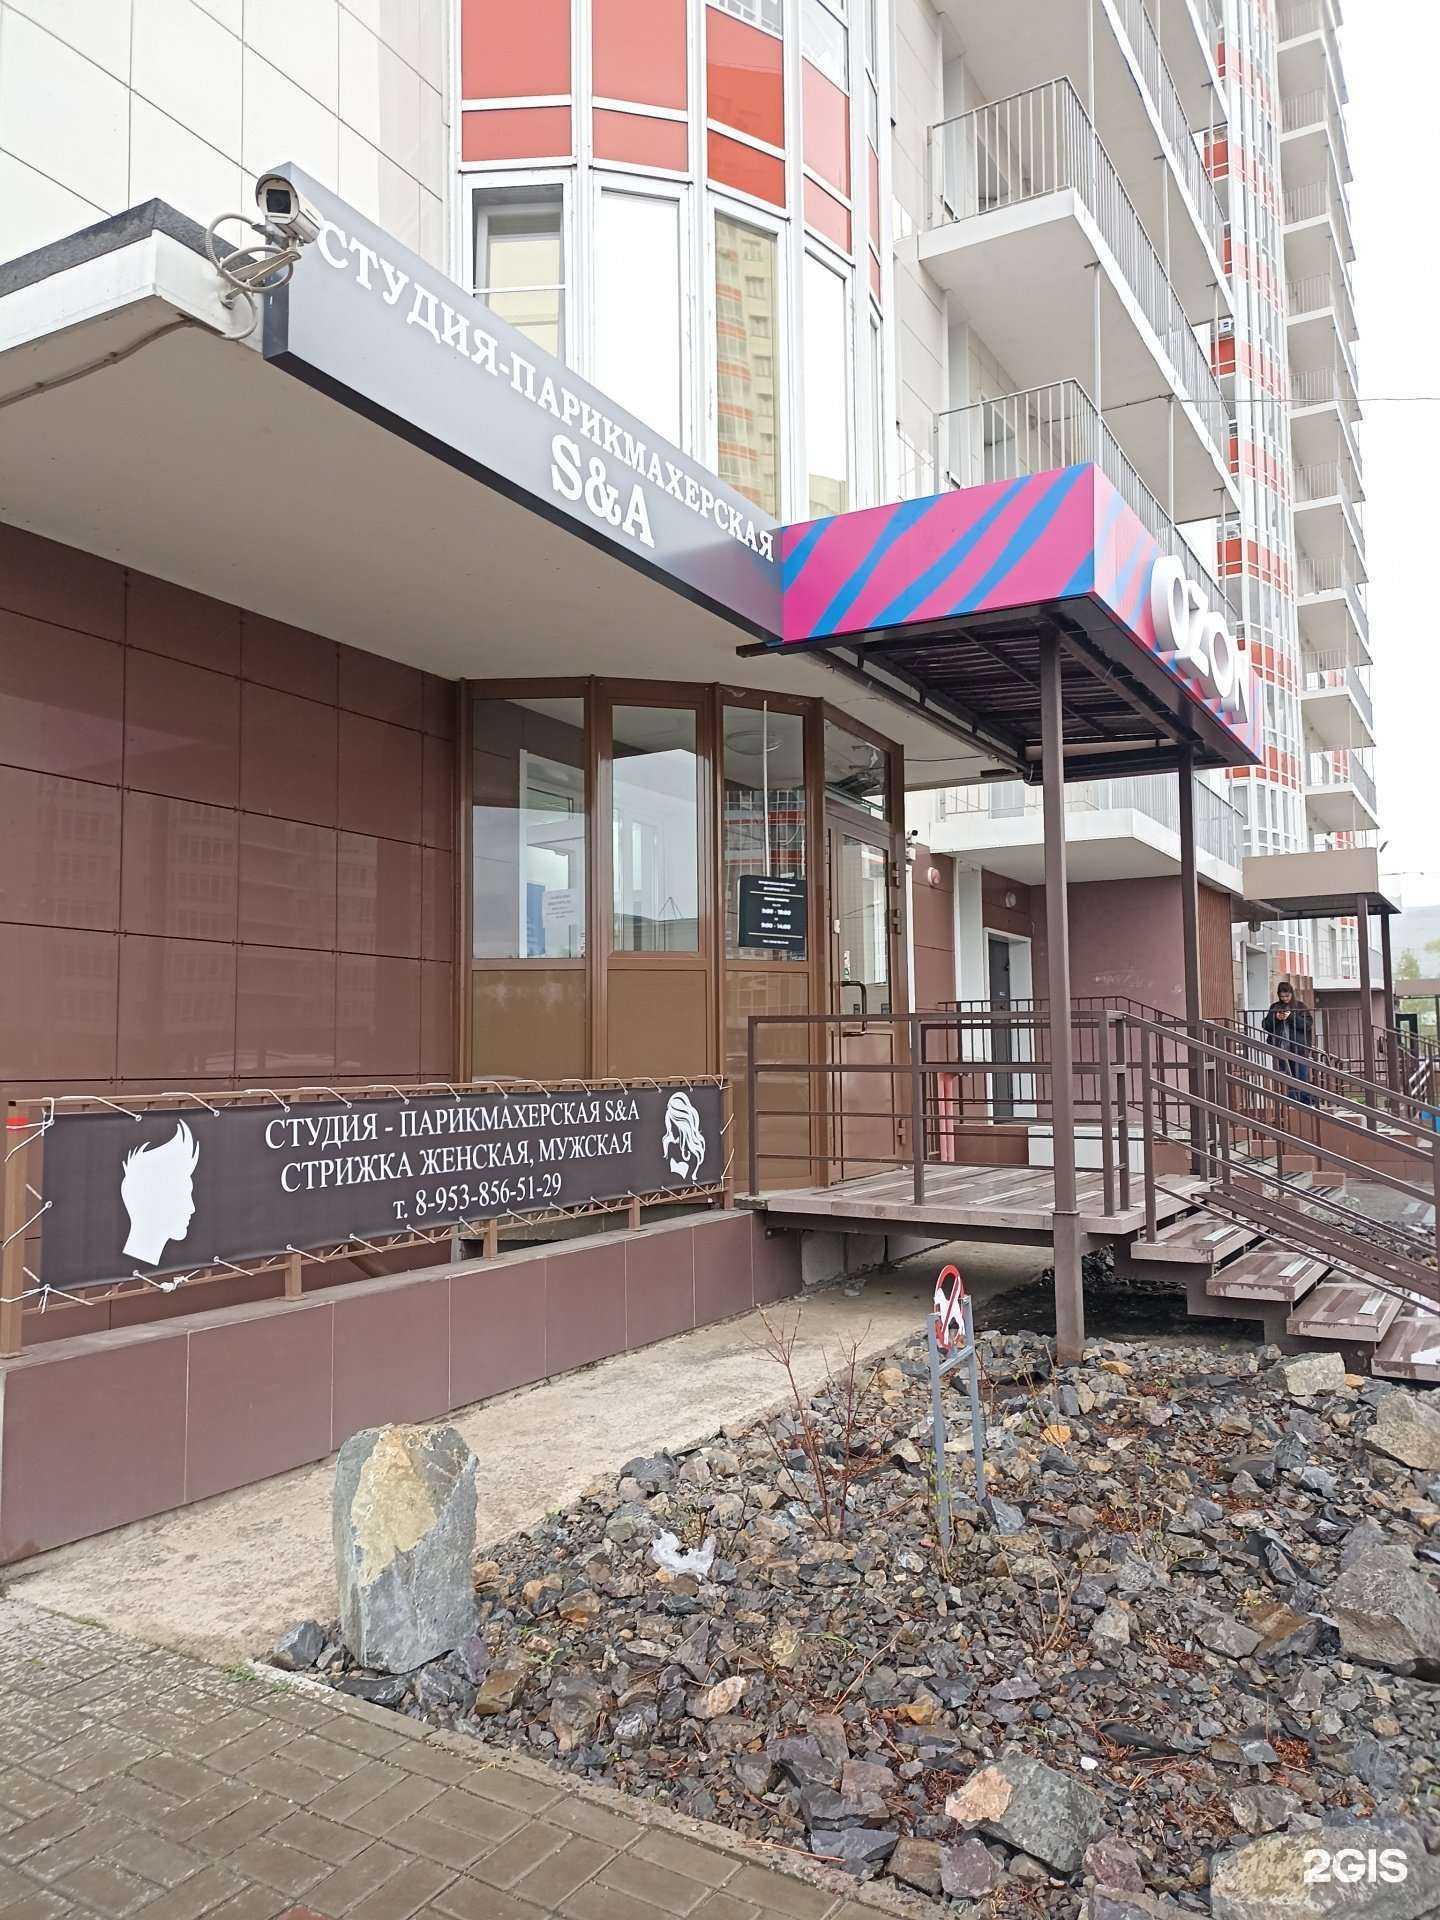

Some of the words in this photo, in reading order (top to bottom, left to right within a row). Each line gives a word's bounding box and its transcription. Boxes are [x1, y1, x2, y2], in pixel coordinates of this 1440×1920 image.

[316, 219, 774, 563] СТУДИЯ-ПАРИКМАХЕРСКАЯ
[551, 434, 655, 549] S&A
[265, 1112, 378, 1151] СТУДИЯ
[400, 1101, 600, 1137] ПАРИКМАХЕРСКАЯ
[605, 1099, 640, 1122] S&A
[280, 1151, 414, 1193] СТРИЖКА
[419, 1139, 534, 1176] ЖЕНСКАЯ,
[538, 1131, 633, 1162] МУЖСКАЯ
[392, 1200, 409, 1219] т.
[415, 1172, 562, 1217] 8-953-856-51-29
